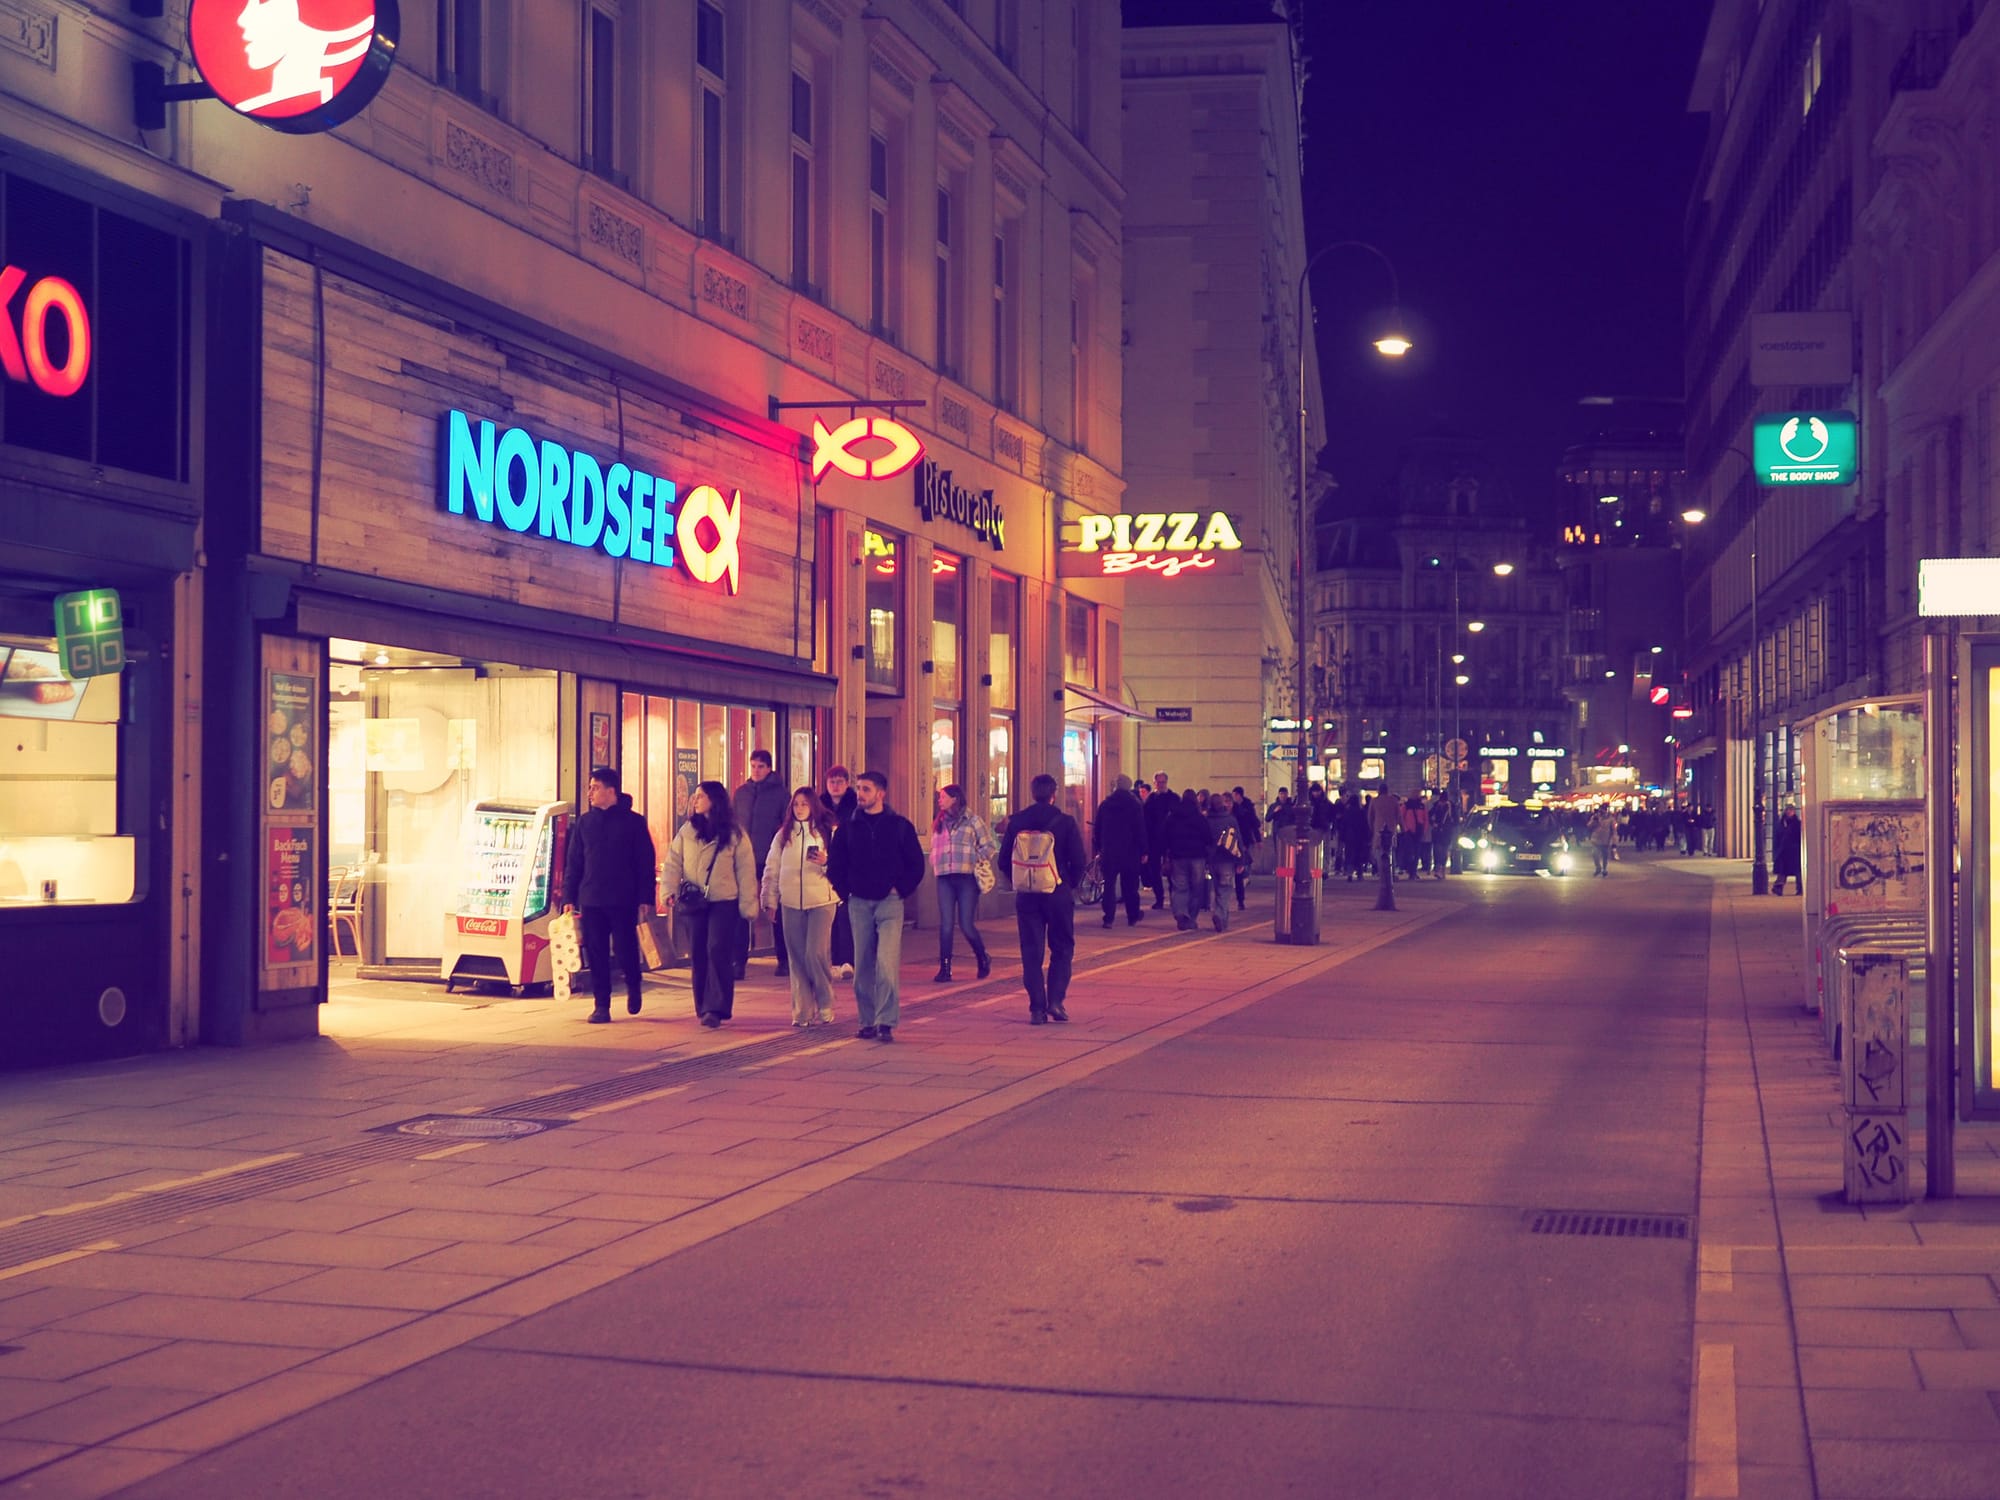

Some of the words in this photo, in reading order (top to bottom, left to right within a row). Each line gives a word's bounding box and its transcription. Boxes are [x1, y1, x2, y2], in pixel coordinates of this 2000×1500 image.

[448, 409, 677, 568] NORDSEE
[1770, 472, 1789, 482] THE
[1789, 472, 1814, 482] BODY
[1814, 471, 1840, 481] SHOP
[915, 455, 1005, 550] Ristorante
[1078, 511, 1242, 552] PIZZA
[67, 597, 118, 626] TO
[72, 640, 121, 670] GO
[1283, 749, 1312, 757] EINBN
